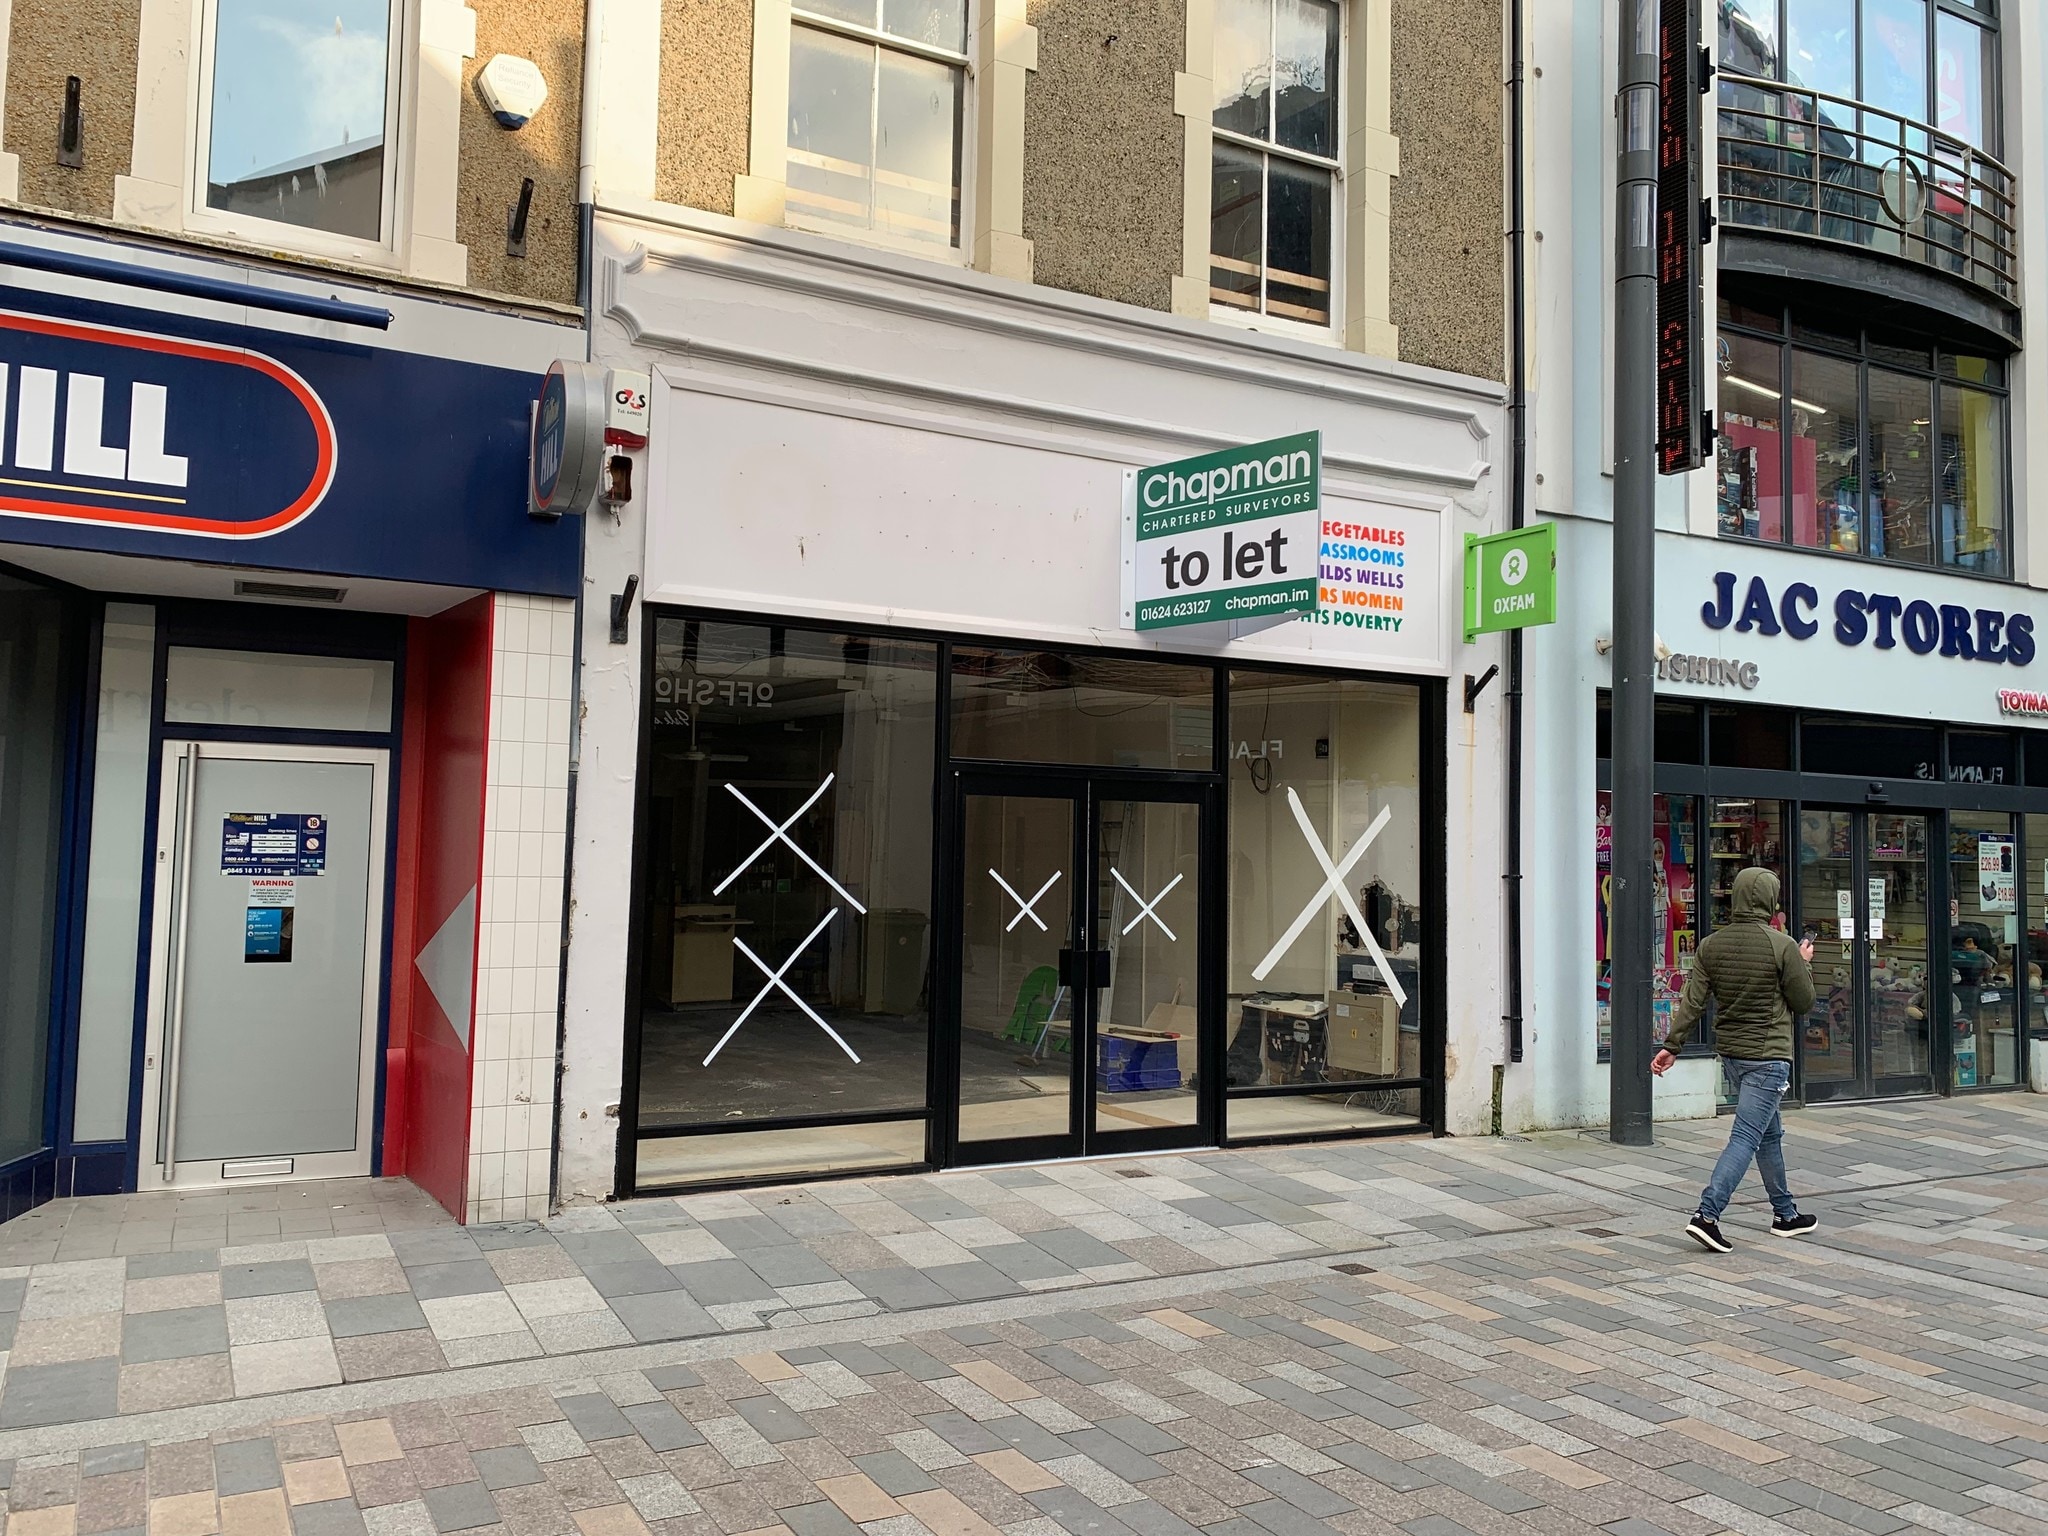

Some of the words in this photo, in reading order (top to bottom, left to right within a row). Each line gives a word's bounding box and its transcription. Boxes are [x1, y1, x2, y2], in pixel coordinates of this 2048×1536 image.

[615, 388, 646, 410] G4S
[0, 362, 188, 488] ILL
[540, 428, 558, 487] HILL
[1143, 450, 1311, 508] Chapman
[1142, 509, 1216, 533] CHARTERED
[1225, 491, 1311, 517] SURVEYORS
[1321, 520, 1405, 546] EGETABLES
[1161, 545, 1210, 590] to
[1222, 527, 1288, 581] let
[1320, 542, 1404, 567] ASSROOMS
[1320, 564, 1352, 582] ILDS
[1356, 569, 1404, 589] WELLS
[1141, 605, 1172, 621] 01624
[1173, 599, 1211, 617] 623127
[1225, 588, 1309, 610] chapman.im
[1320, 587, 1338, 604] RS
[1341, 590, 1403, 611] WOMEN
[1493, 592, 1535, 615] OXFAM
[1333, 610, 1403, 632] POVERTY
[1701, 571, 1819, 641] JAC
[1834, 588, 2036, 667] STORES
[1657, 653, 1760, 690] ISHING
[309, 819, 318, 827] 18
